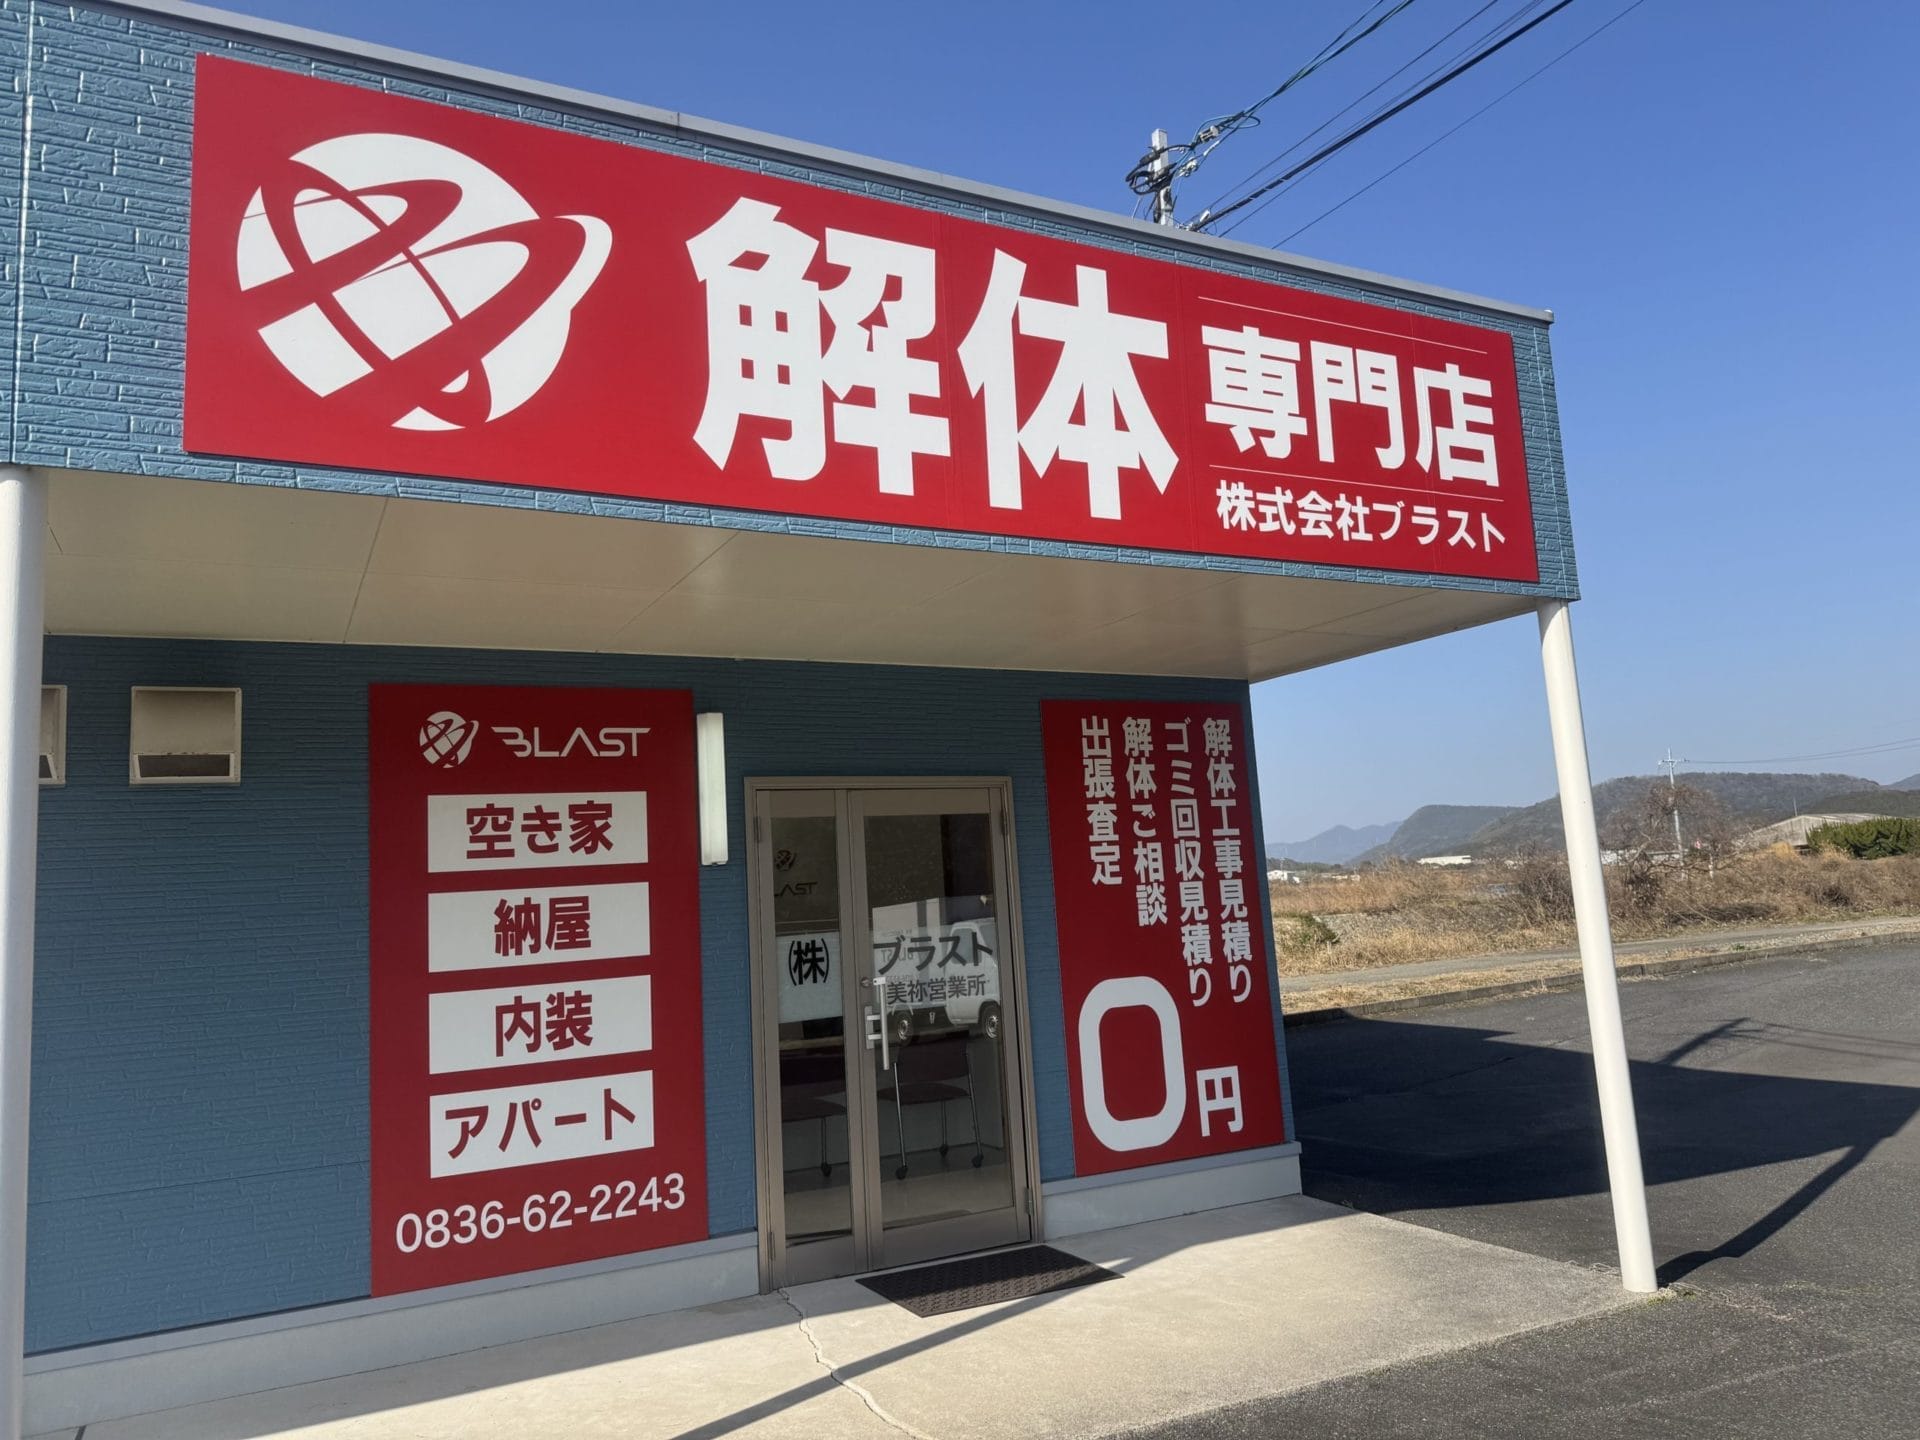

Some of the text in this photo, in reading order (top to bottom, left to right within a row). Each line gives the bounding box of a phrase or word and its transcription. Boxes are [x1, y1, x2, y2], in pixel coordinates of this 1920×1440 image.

[686, 197, 1499, 521] 解体 専門店
[1215, 479, 1506, 553] 株式会社ブラスト
[491, 726, 650, 758] BLAST
[465, 800, 614, 860] 空き家
[1081, 715, 1122, 886] 出張査定
[1122, 717, 1168, 927] 解体ご相談
[1165, 717, 1213, 1008] ゴミ回収見積り
[1203, 717, 1253, 1004] 解体工事見積り
[493, 895, 592, 957] 納屋
[788, 931, 993, 986] (株) ブラスト
[494, 991, 593, 1057] 内装
[444, 1087, 637, 1159] アパート
[395, 1172, 686, 1254] 0836-62-2243
